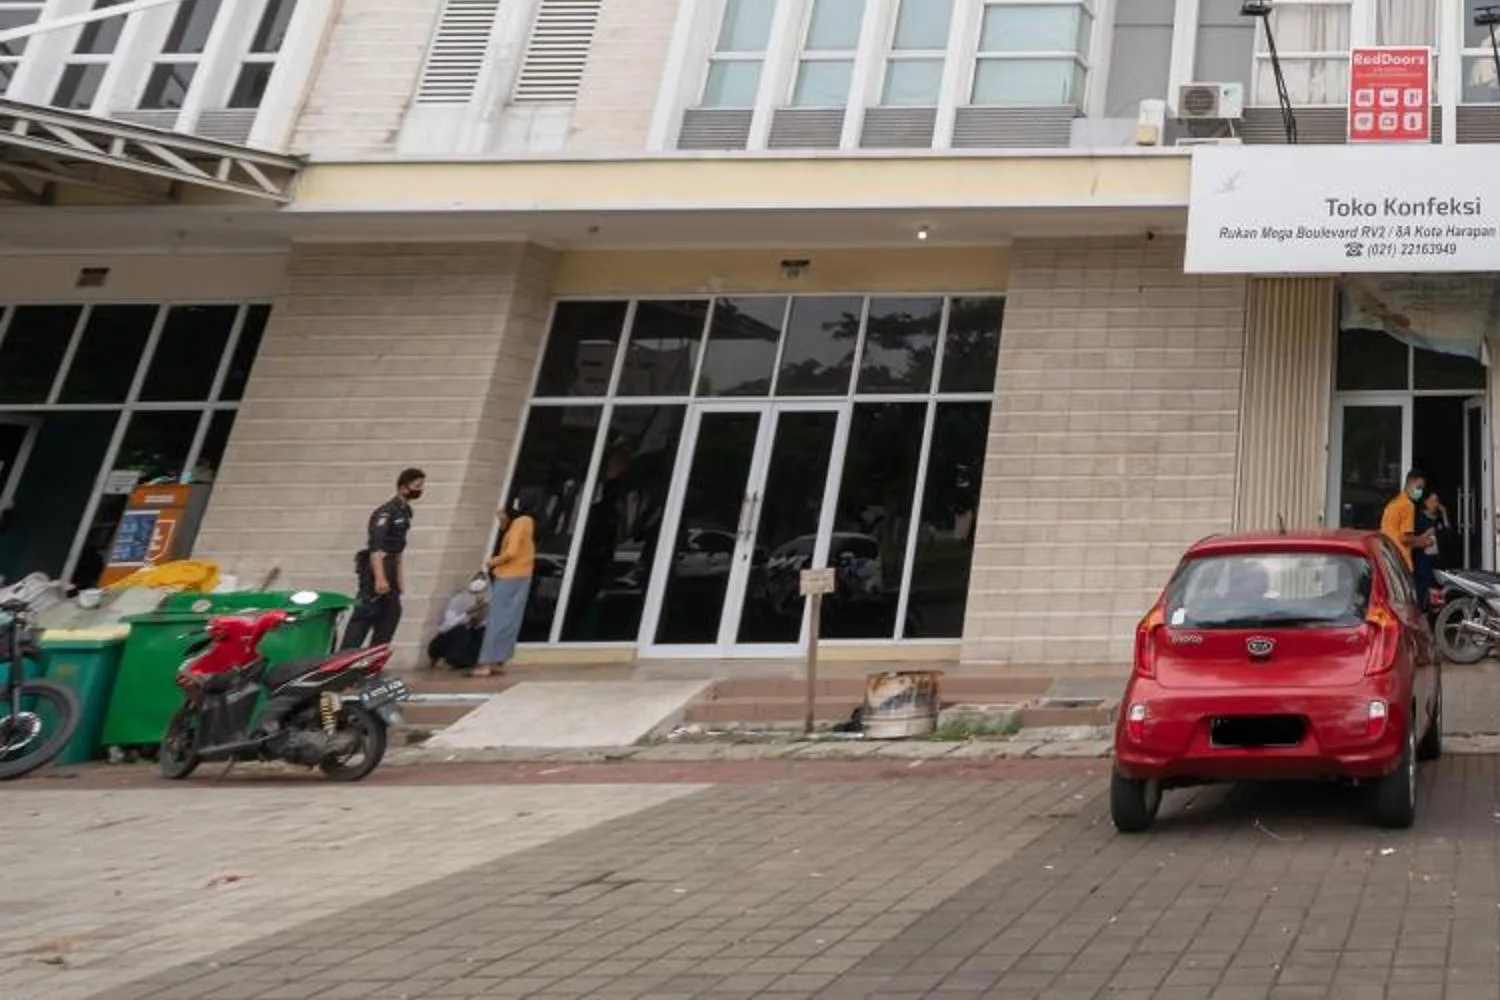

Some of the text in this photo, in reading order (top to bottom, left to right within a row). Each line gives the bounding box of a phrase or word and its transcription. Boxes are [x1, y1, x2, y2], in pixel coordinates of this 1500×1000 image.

[1353, 51, 1425, 65] RedDoorz
[1326, 196, 1481, 217] Toko Konfeksi
[1219, 227, 1257, 240] Rukan
[1261, 226, 1293, 242] Mega
[1296, 226, 1358, 240] Boulevard
[1361, 225, 1386, 239] RV2
[1415, 225, 1443, 238] Kota
[1446, 225, 1496, 240] Harapan
[1367, 242, 1397, 257] (021)
